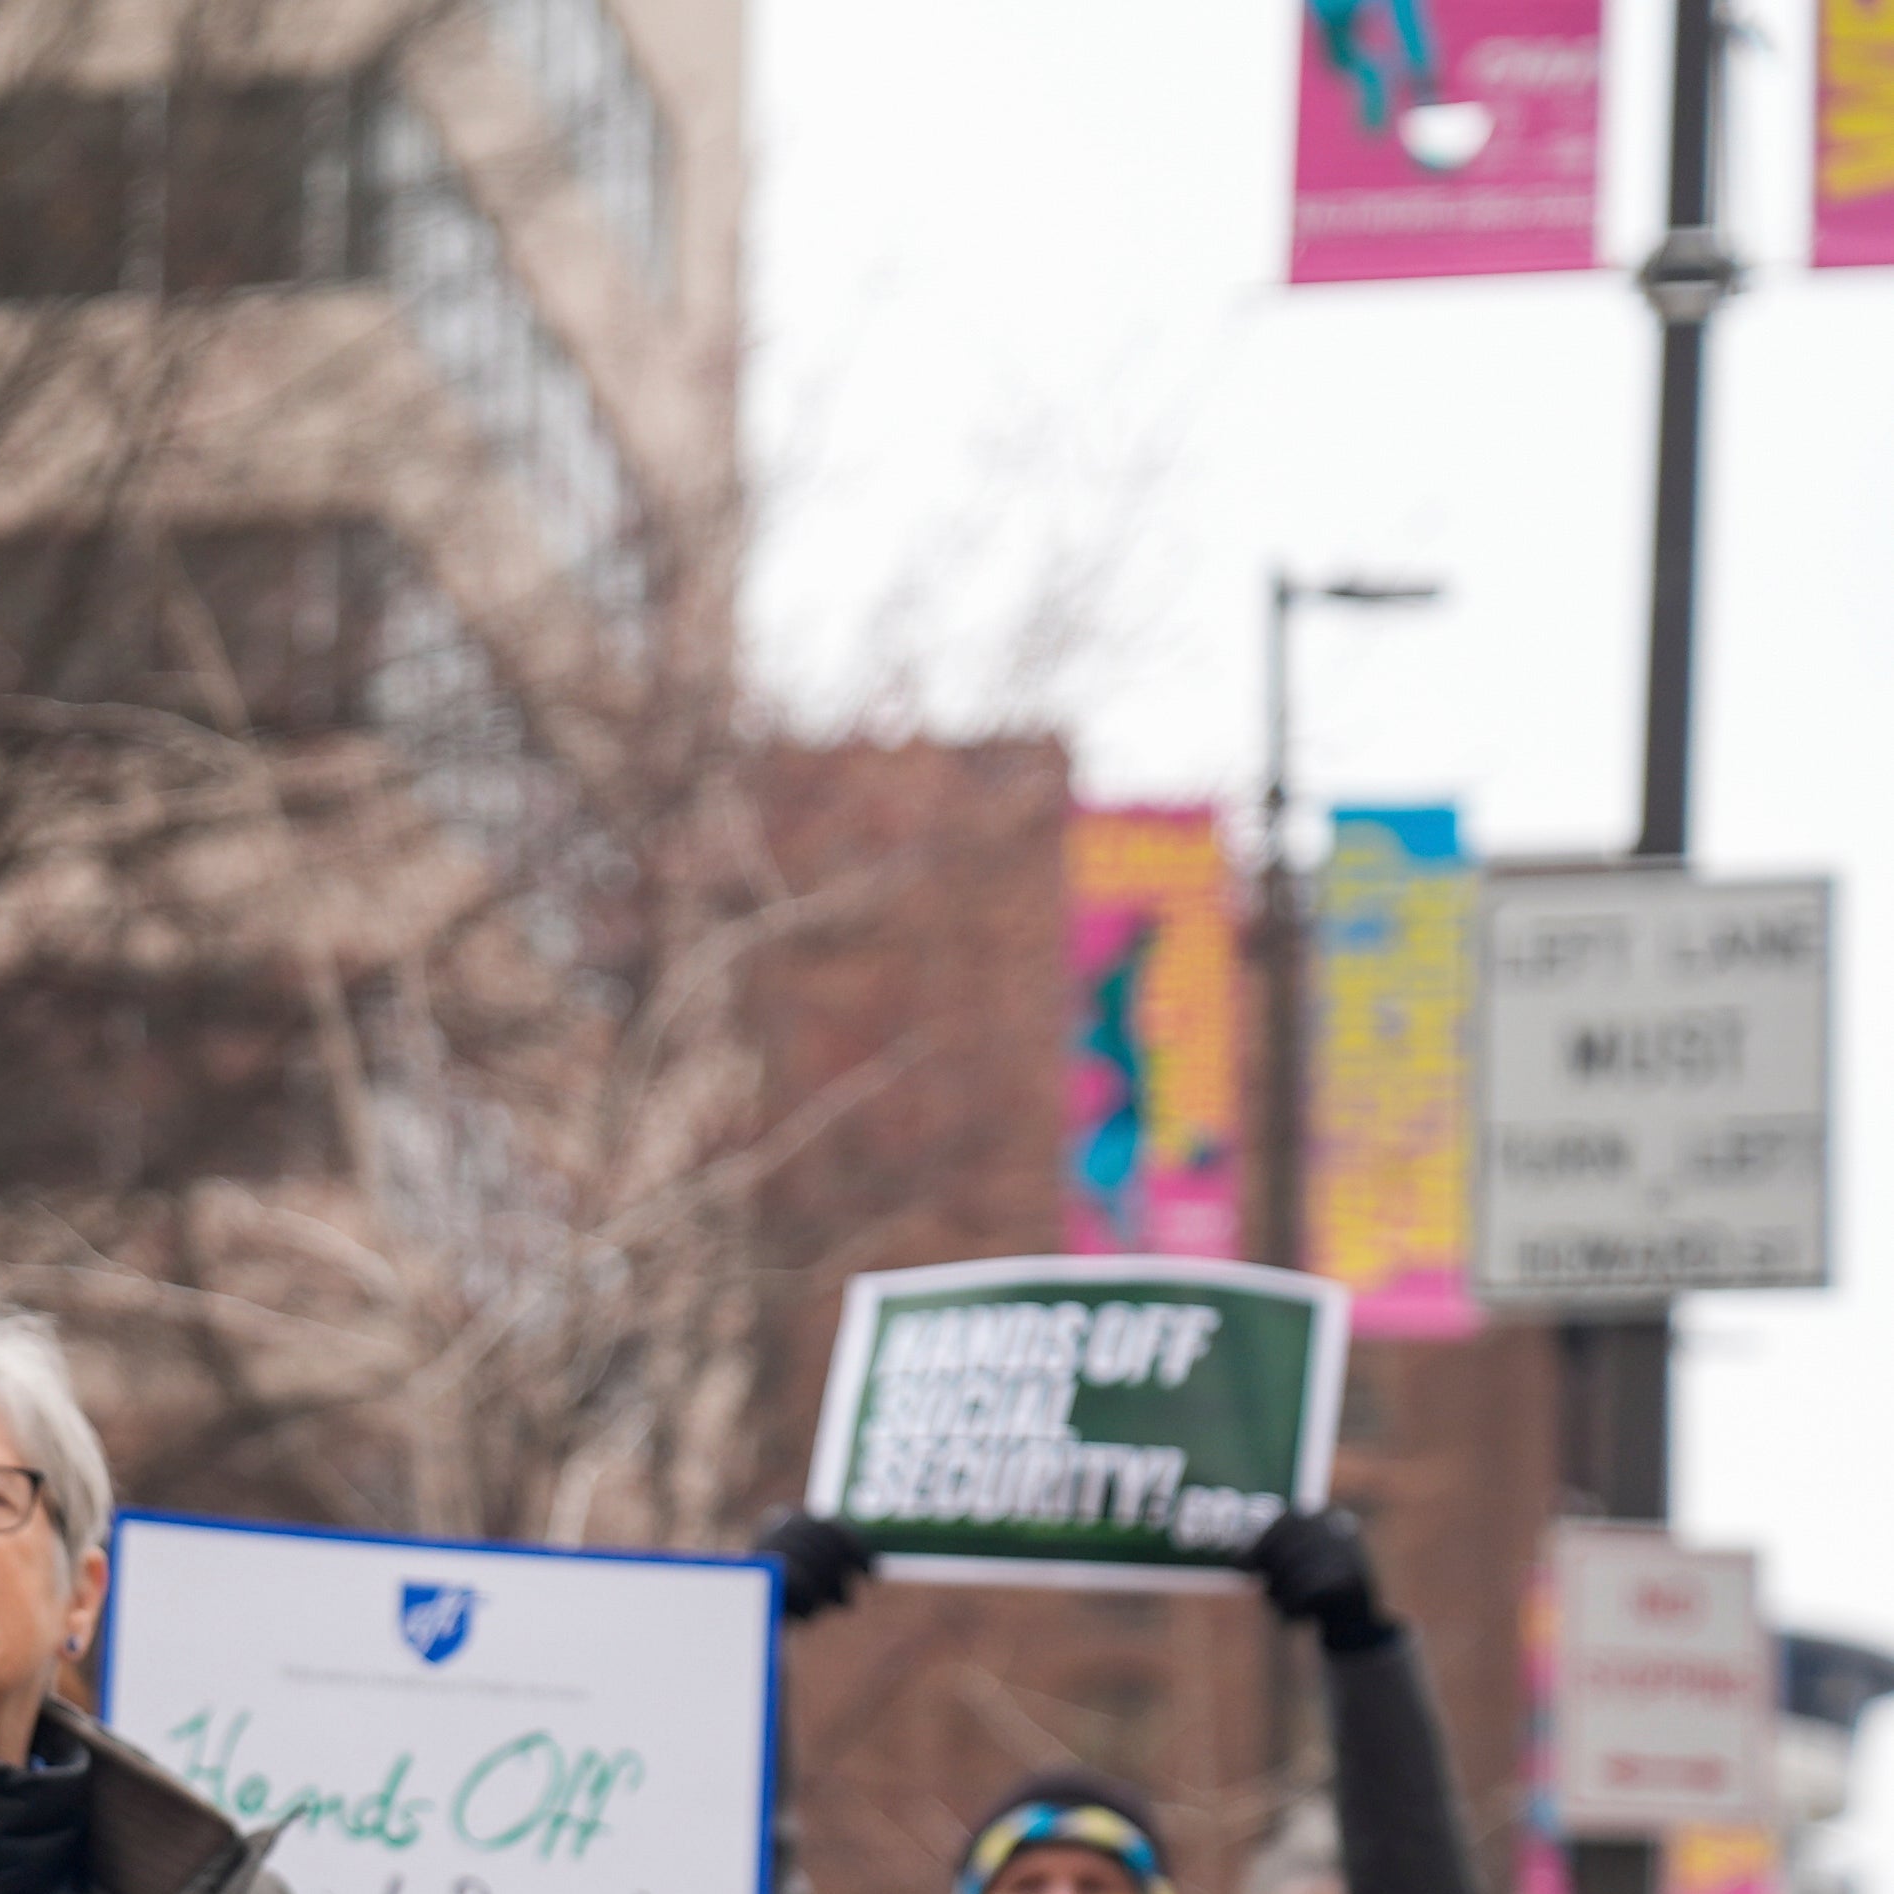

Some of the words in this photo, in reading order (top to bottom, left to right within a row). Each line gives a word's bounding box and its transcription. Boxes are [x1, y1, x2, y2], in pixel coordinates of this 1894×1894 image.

[876, 1300, 1089, 1374] HANDS
[1083, 1300, 1223, 1388] OFF
[166, 1705, 433, 1850] Hands
[451, 1728, 645, 1858] Off
